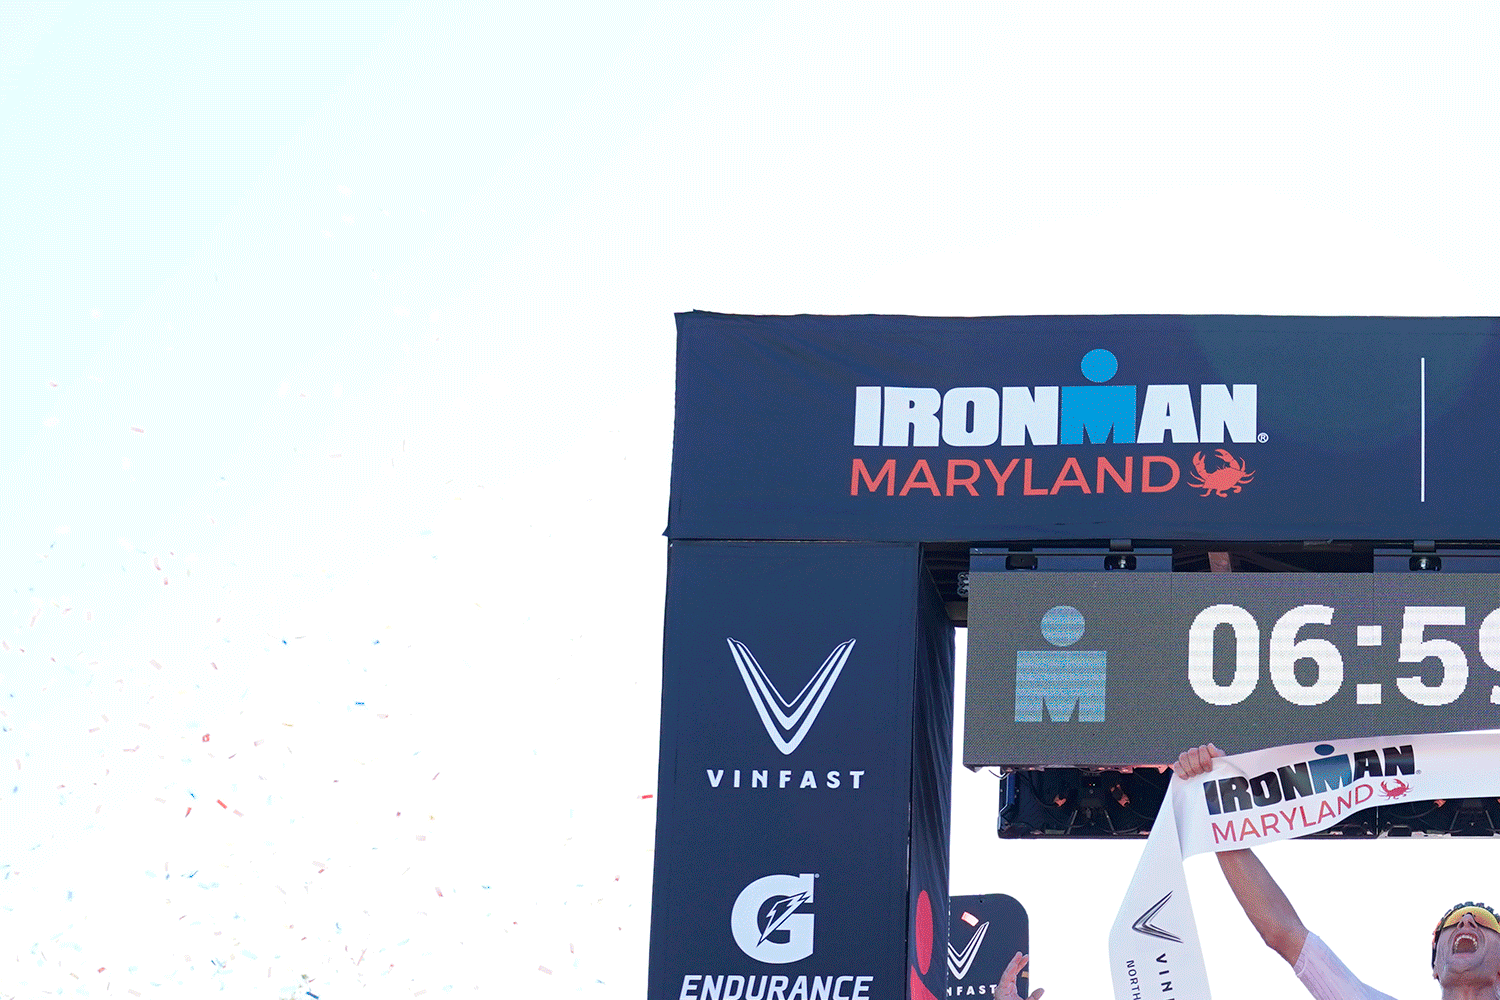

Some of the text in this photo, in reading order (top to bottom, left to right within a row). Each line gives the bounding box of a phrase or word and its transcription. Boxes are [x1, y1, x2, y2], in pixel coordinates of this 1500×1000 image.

[853, 383, 1257, 447] IRONMAN
[849, 455, 1180, 497] MARYLAND
[707, 768, 864, 789] VINFAST
[1203, 745, 1416, 816] IRONMAN
[1211, 784, 1374, 844] MARYLAND
[946, 984, 998, 997] NFAST
[1126, 959, 1141, 1000] NORTH
